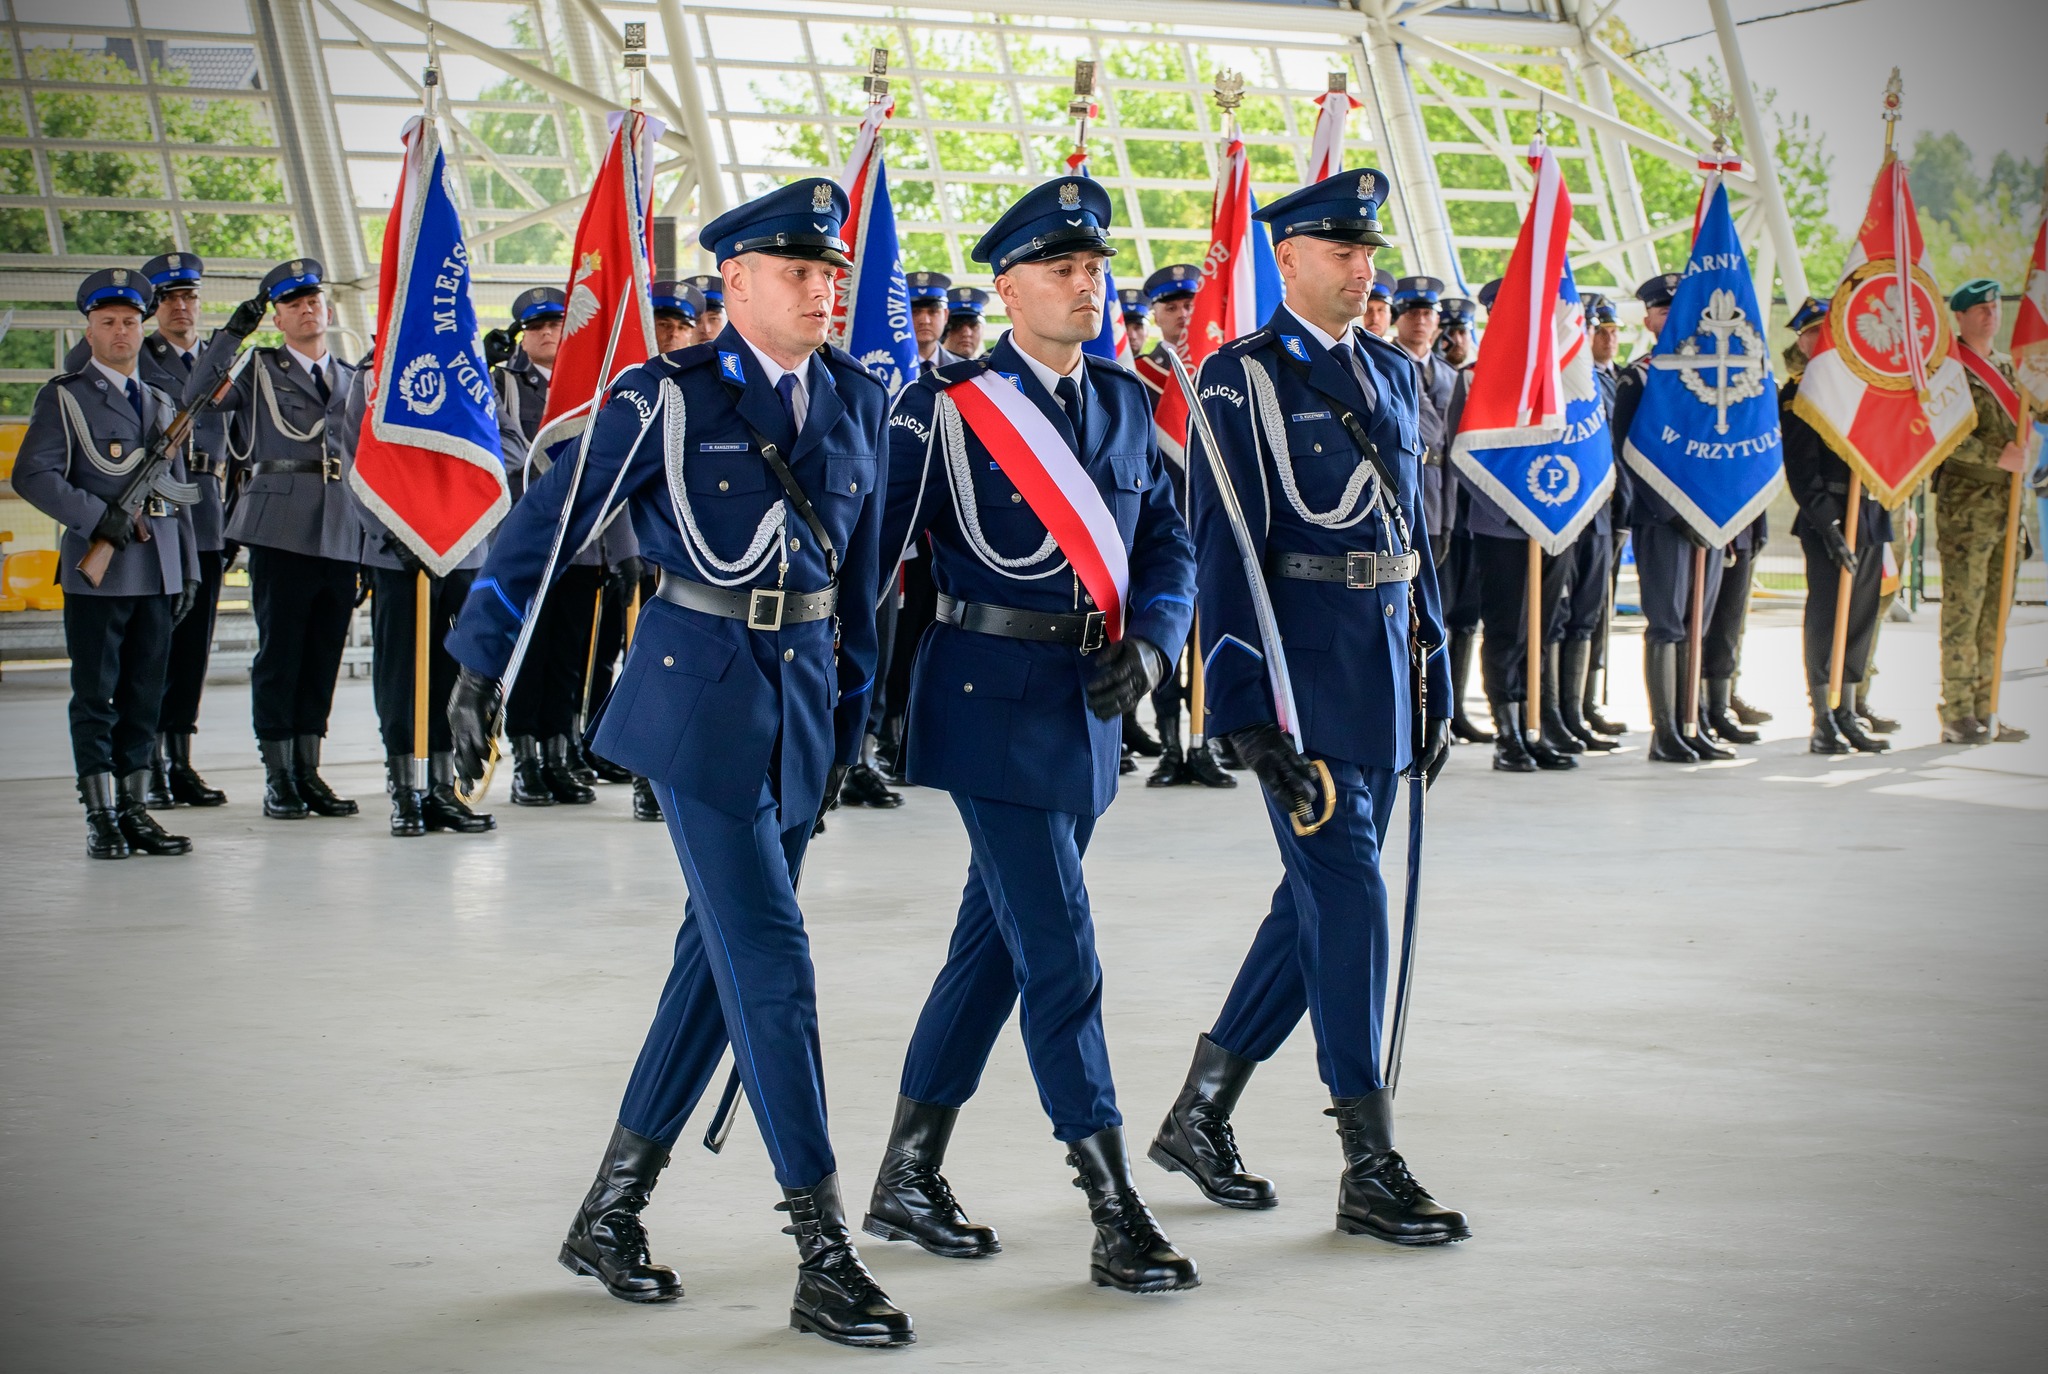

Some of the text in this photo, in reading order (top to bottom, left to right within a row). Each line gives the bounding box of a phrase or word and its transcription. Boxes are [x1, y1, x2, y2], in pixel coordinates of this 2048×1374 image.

[616, 390, 651, 429] POLICJA
[1661, 425, 1681, 444] W
[1547, 468, 1564, 489] P
